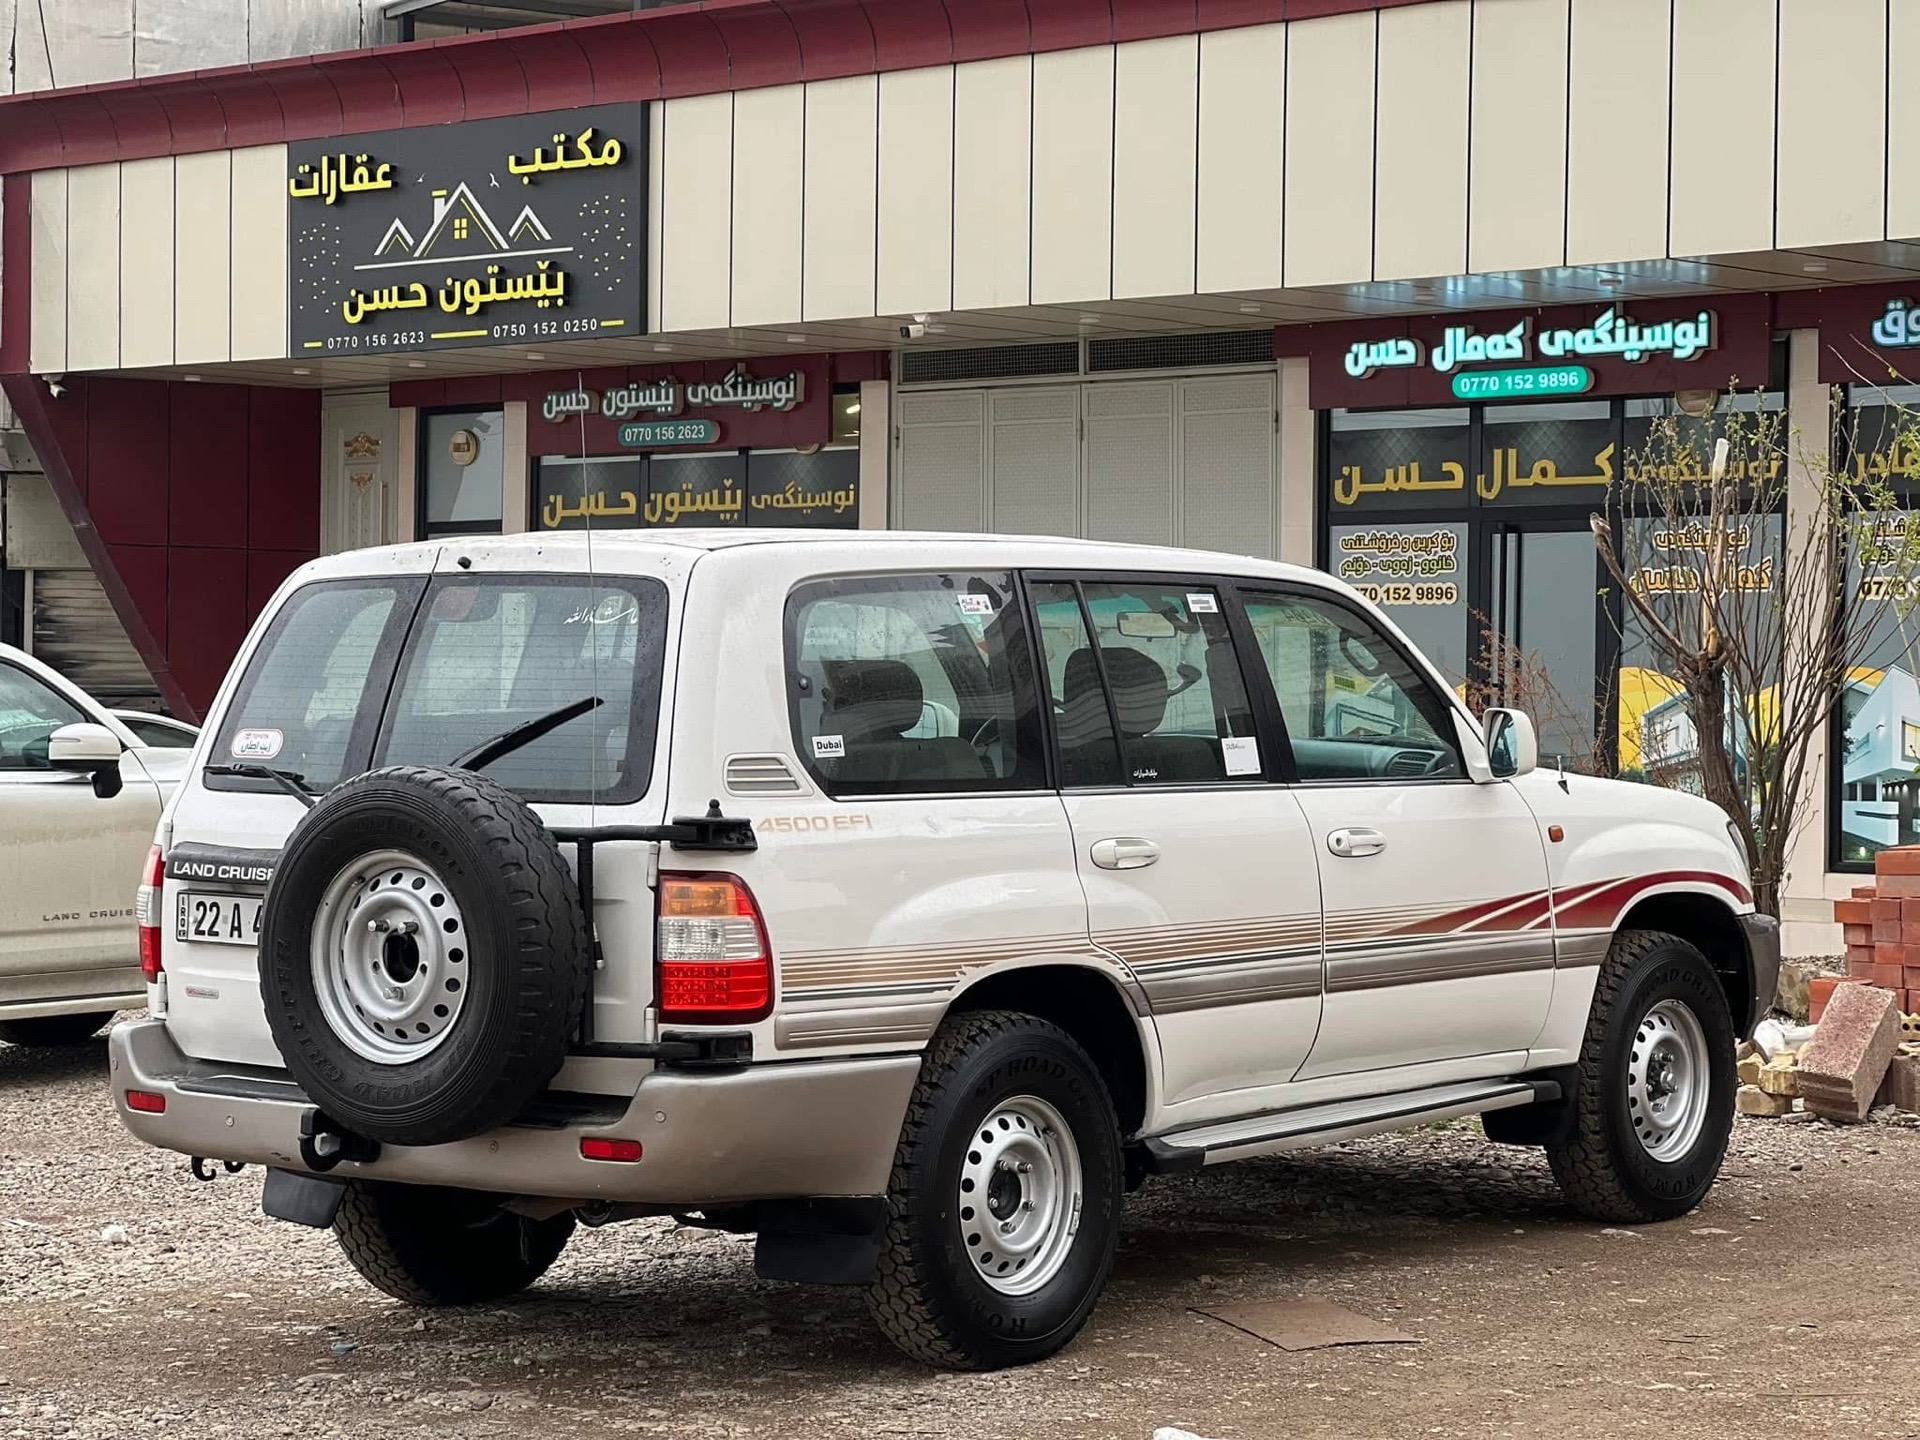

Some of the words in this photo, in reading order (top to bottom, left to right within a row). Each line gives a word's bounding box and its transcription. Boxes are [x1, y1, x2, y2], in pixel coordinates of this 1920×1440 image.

[508, 128, 622, 184] مكتب
[289, 153, 393, 205] عقارات
[342, 282, 428, 325] حسن
[493, 323, 526, 338] 0750
[533, 321, 558, 335] 152
[564, 318, 598, 332] 0250
[327, 335, 359, 350] 0770
[364, 334, 388, 347] 156
[393, 331, 425, 345] 2623
[1345, 338, 1417, 377] حسن
[1460, 374, 1500, 392] 0770
[1505, 373, 1535, 390] 152
[1539, 371, 1580, 388] 9896
[543, 391, 590, 418] حسن
[625, 428, 651, 442] 0770
[655, 427, 675, 440] 156
[678, 424, 705, 439] 2623
[1334, 460, 1465, 505] حسن
[543, 491, 637, 528] حسن
[1355, 587, 1378, 600] 70
[1382, 586, 1411, 601] 152
[1416, 586, 1454, 601] 9896
[816, 740, 842, 750] Dubai
[757, 816, 828, 833] 4500
[832, 814, 872, 831] EFI
[173, 861, 215, 878] LAND
[218, 865, 274, 881] CRUISE
[42, 912, 80, 922] LAND
[89, 907, 136, 919] CRUIS
[194, 901, 220, 937] 22
[229, 903, 242, 938] A
